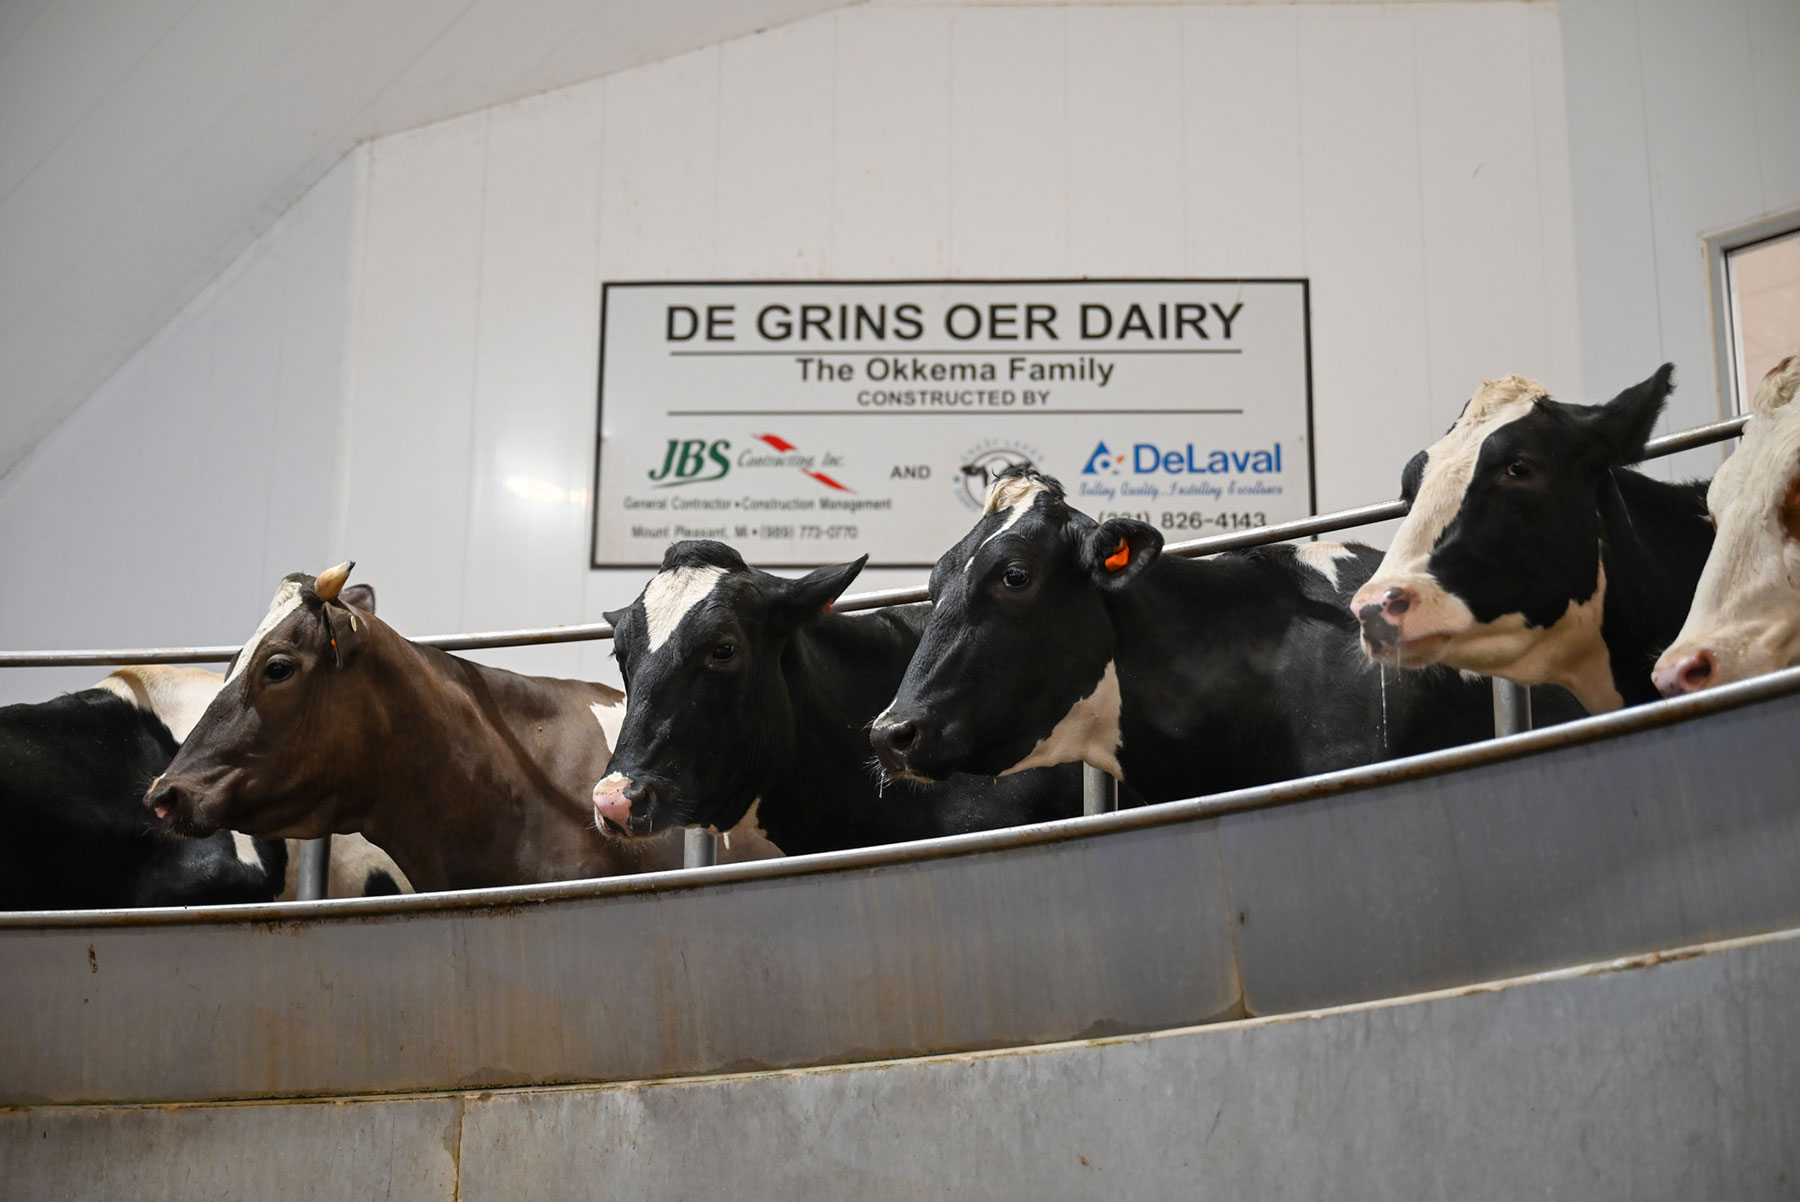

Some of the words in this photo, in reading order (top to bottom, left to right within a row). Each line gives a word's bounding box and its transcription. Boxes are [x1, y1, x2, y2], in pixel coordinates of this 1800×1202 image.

[666, 305, 736, 342] DE
[756, 304, 923, 342] GRINS
[945, 303, 1059, 340] OER
[1079, 302, 1243, 340] DAIRY
[796, 357, 854, 382] The
[866, 357, 996, 382] Okkema
[1008, 356, 1114, 387] Family
[857, 390, 1015, 406] CONSTRUCTED
[1022, 390, 1050, 406] BY
[648, 439, 731, 481] JBS
[737, 448, 815, 468] Contracting
[1133, 442, 1281, 475] DeLaval
[889, 465, 931, 479] AND
[623, 497, 667, 511] General
[671, 497, 731, 511] Contractor
[741, 497, 814, 511] Construction
[819, 498, 892, 514] Management
[1161, 510, 1266, 530] 826-4143
[632, 526, 669, 539] Mount
